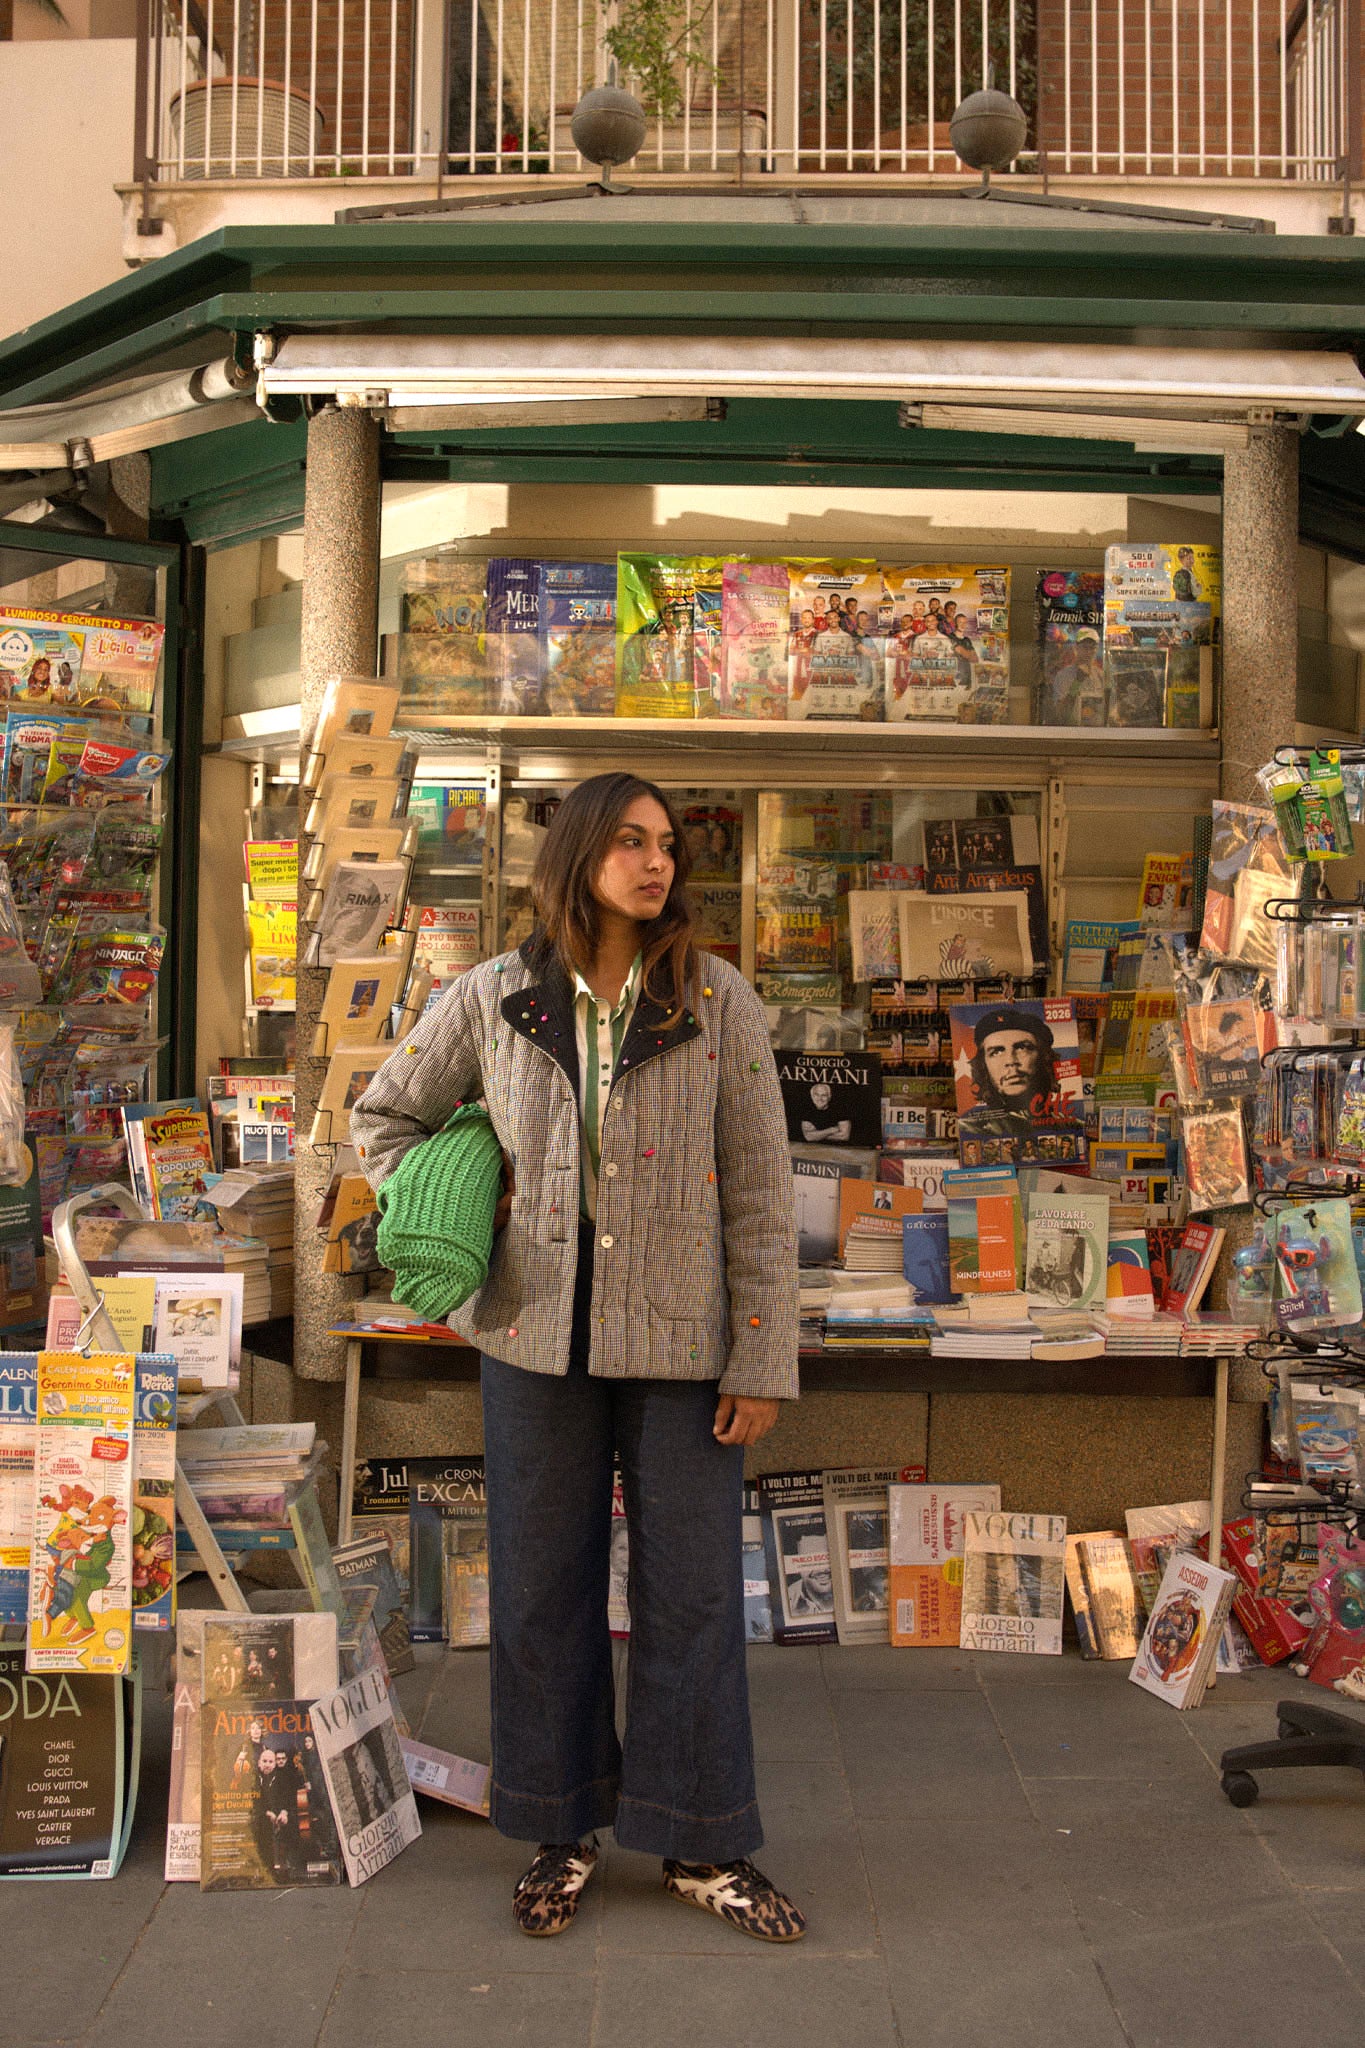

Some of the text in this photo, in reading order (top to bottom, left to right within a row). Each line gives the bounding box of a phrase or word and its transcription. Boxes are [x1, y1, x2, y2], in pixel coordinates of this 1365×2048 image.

[5, 609, 58, 624] LUMINOSO
[61, 614, 120, 629] CERCHIETTO
[434, 911, 477, 922] EXTRA
[931, 905, 995, 929] L'INDICE
[1045, 1009, 1071, 1019] 2026
[796, 1057, 850, 1068] GIORGIO
[779, 1066, 871, 1086] ARMANI
[1029, 1090, 1077, 1118] CHE
[156, 1120, 203, 1146] SUPERMAN
[156, 1160, 206, 1175] TOPOLINO
[796, 1162, 840, 1179] RIMINI
[1034, 1209, 1086, 1220] LAVORARE
[1034, 1220, 1095, 1230] PEDALANDO
[957, 1269, 1012, 1281] MINDFULNESS
[40, 1378, 129, 1391] Geronimo Stilton
[136, 1420, 169, 1430] amico
[768, 1478, 792, 1489] VOLTI
[793, 1477, 809, 1487] DEL
[832, 1474, 856, 1484] VOLTI
[857, 1473, 872, 1483] DEL
[874, 1471, 897, 1482] MALE
[369, 1495, 401, 1505] romanzi
[922, 1508, 931, 1545] CREED
[930, 1494, 939, 1560] ASSASSIN'S
[966, 1512, 1066, 1543] VOGUE
[338, 1555, 378, 1577] BATMAN
[919, 1575, 930, 1640] FIGHTER
[930, 1578, 941, 1637] STREET
[962, 1612, 1035, 1637] Giorgio
[963, 1630, 1036, 1653] Armani
[317, 1671, 387, 1735] VOGUE
[43, 1740, 76, 1751] CHANEL
[48, 1755, 70, 1764] DIOR
[44, 1768, 73, 1778] GUCCI
[27, 1780, 89, 1793] LOUIS VUITTON
[43, 1795, 71, 1805] PRADA
[16, 1807, 96, 1820] YVES SAINT LAURENT
[37, 1823, 72, 1833] CARTIER
[347, 1810, 398, 1857] Giorgio
[35, 1836, 71, 1846] VERSACE
[356, 1832, 405, 1884] Armani
